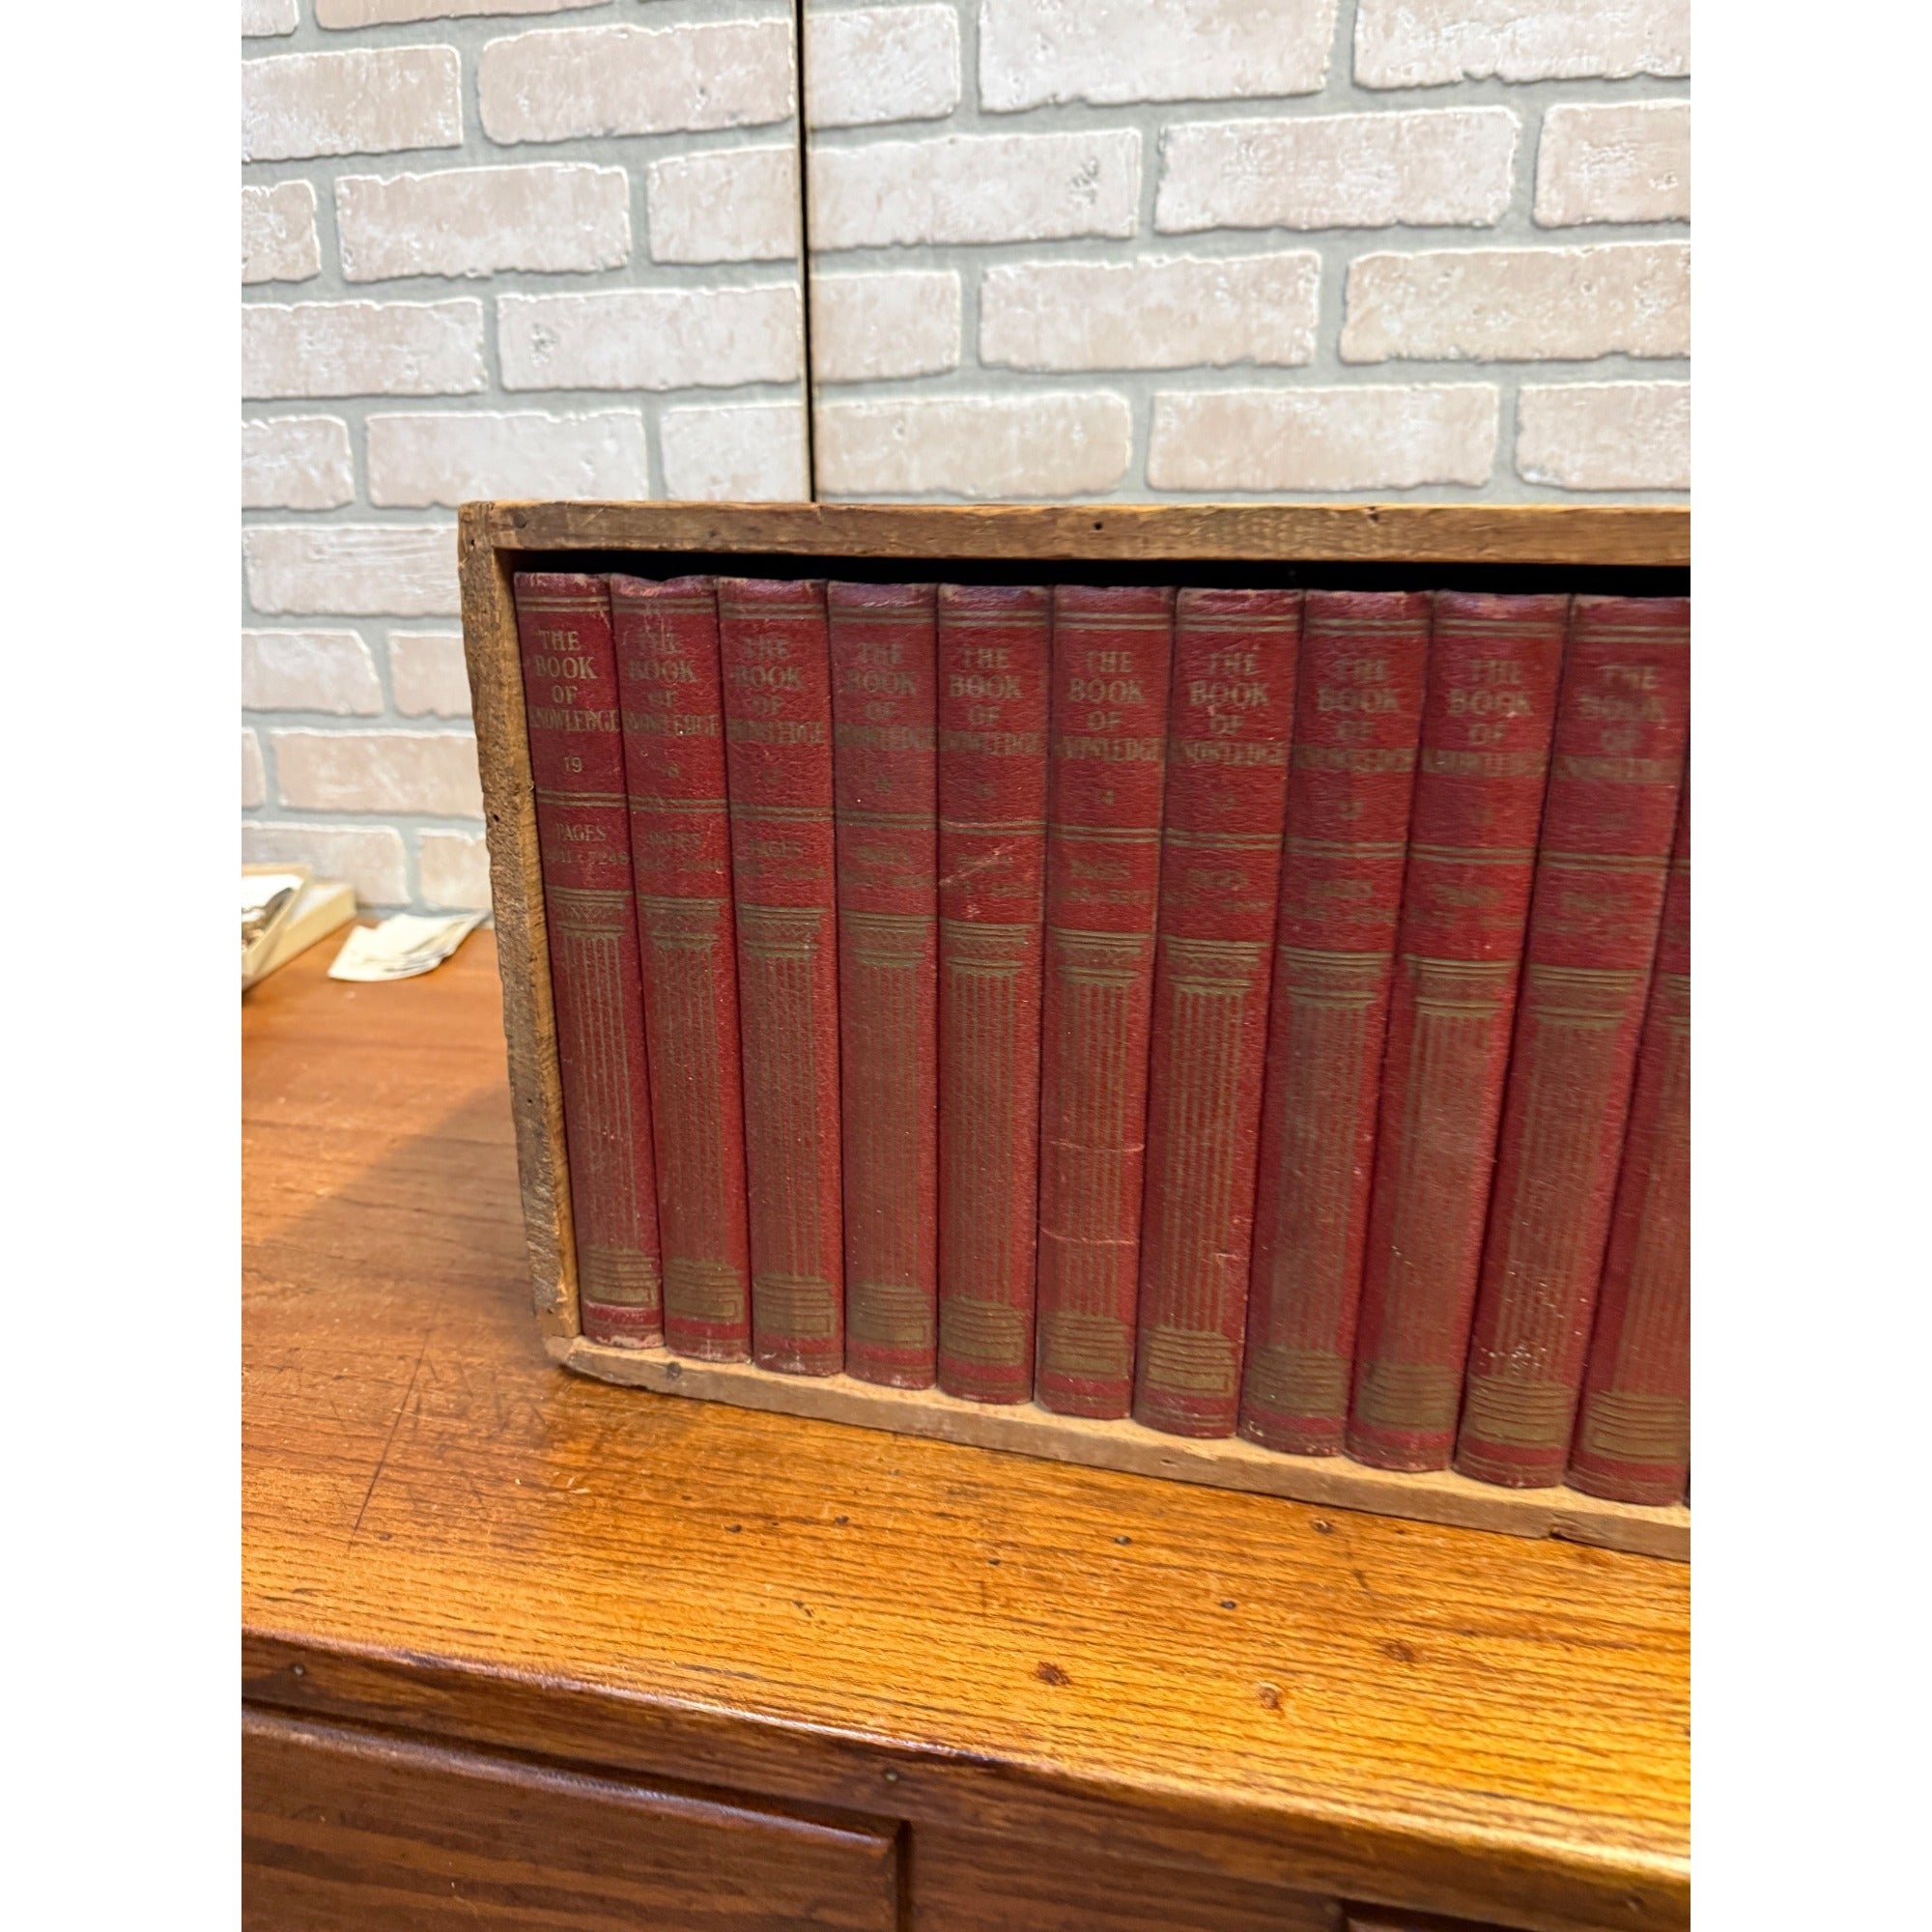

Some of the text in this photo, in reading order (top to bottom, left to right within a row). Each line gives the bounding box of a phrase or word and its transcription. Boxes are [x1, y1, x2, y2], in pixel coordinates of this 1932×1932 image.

[537, 631, 581, 651] THE
[744, 638, 789, 660] THE
[857, 642, 903, 665] THE
[959, 647, 1009, 668] THE
[1085, 651, 1133, 673] THE
[1209, 652, 1257, 675] THE
[536, 655, 597, 679] BOOK
[629, 660, 696, 683] BOOK
[733, 667, 803, 689] BOOK
[846, 671, 916, 696] BOOK
[950, 675, 1021, 698] BOOK
[1067, 679, 1146, 703] BOOK
[1189, 680, 1270, 706] BOOK
[552, 686, 578, 704] OF
[648, 690, 676, 707] OF
[752, 696, 785, 715] OF
[1316, 686, 1399, 713] BOOK
[969, 705, 1001, 724] OF
[1087, 711, 1123, 730] OF
[1209, 714, 1243, 735] OF
[563, 755, 582, 773] 19
[555, 822, 607, 841] PAGES
